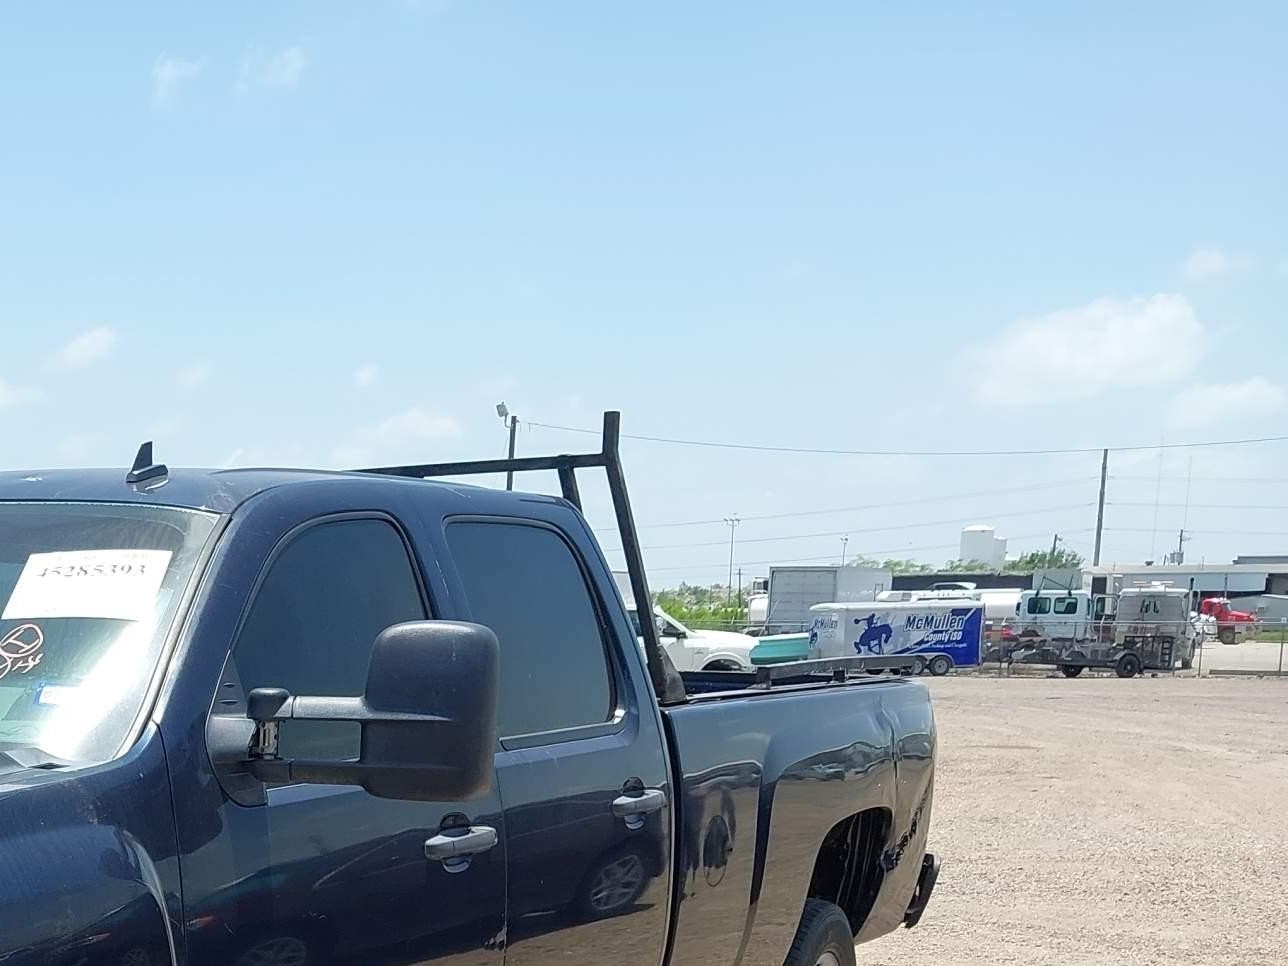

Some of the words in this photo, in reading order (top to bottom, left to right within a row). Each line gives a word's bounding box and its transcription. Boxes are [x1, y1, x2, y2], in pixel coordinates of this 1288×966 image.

[903, 614, 965, 632] McMullen
[924, 631, 950, 642] County
[950, 630, 963, 641] ISD
